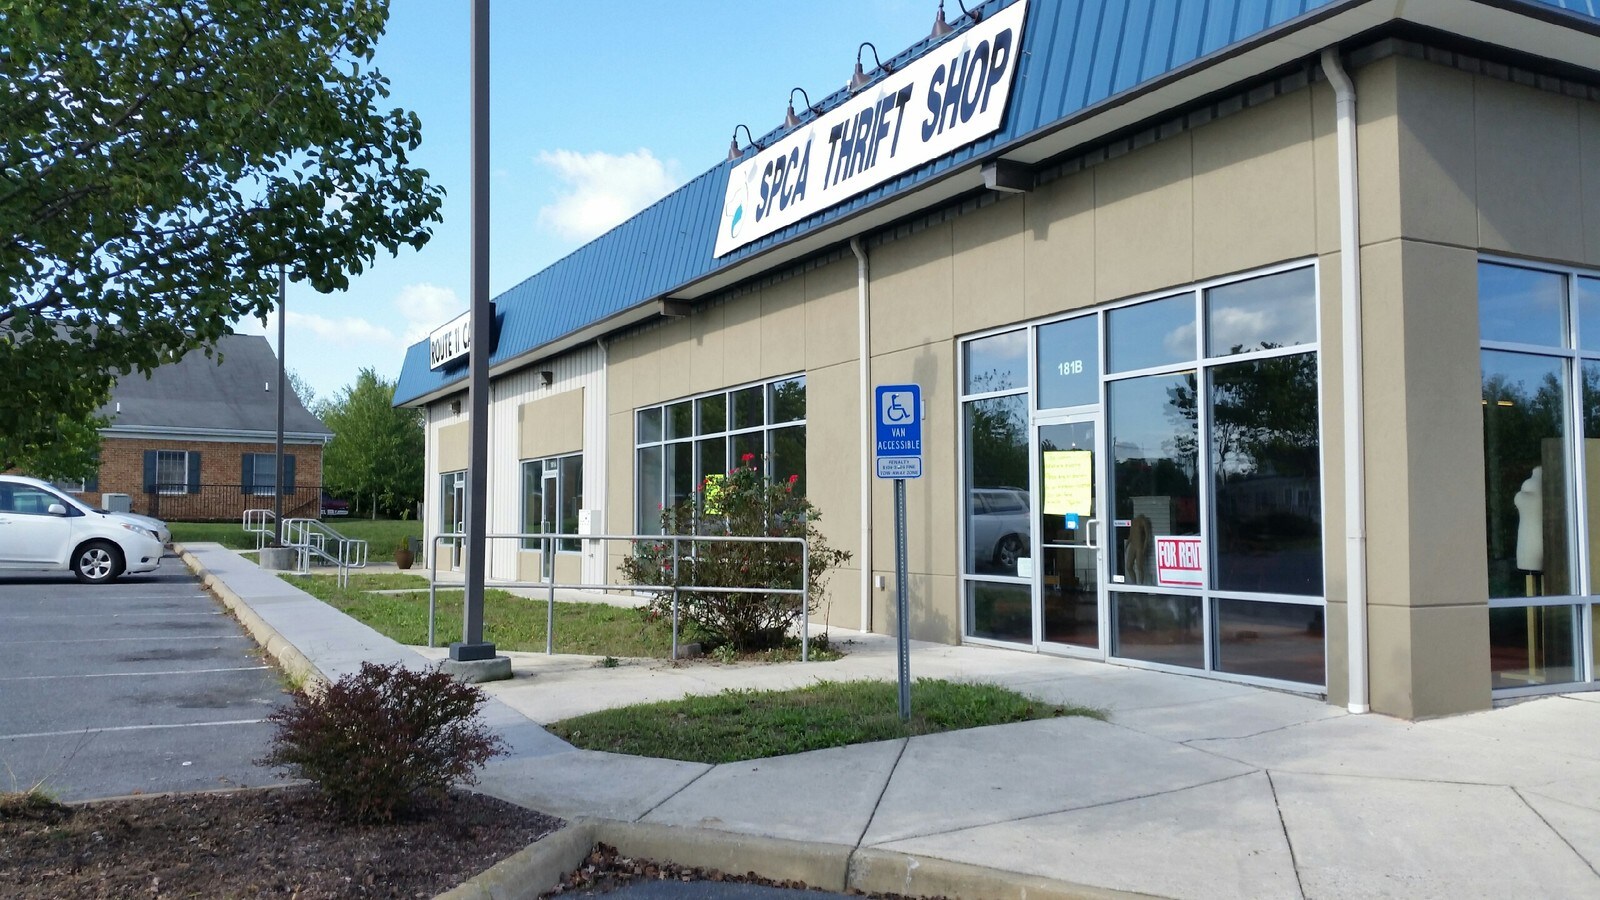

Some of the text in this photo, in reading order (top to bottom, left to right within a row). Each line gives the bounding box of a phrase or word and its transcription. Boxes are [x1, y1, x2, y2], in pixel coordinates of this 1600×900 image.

[755, 27, 1012, 222] SPCA THRIFT SHOP
[431, 331, 452, 365] ROUTE
[1058, 360, 1083, 376] 181B
[891, 427, 906, 437] VAN
[878, 440, 920, 450] ACCESSIBLE
[1158, 541, 1177, 567] FOR
